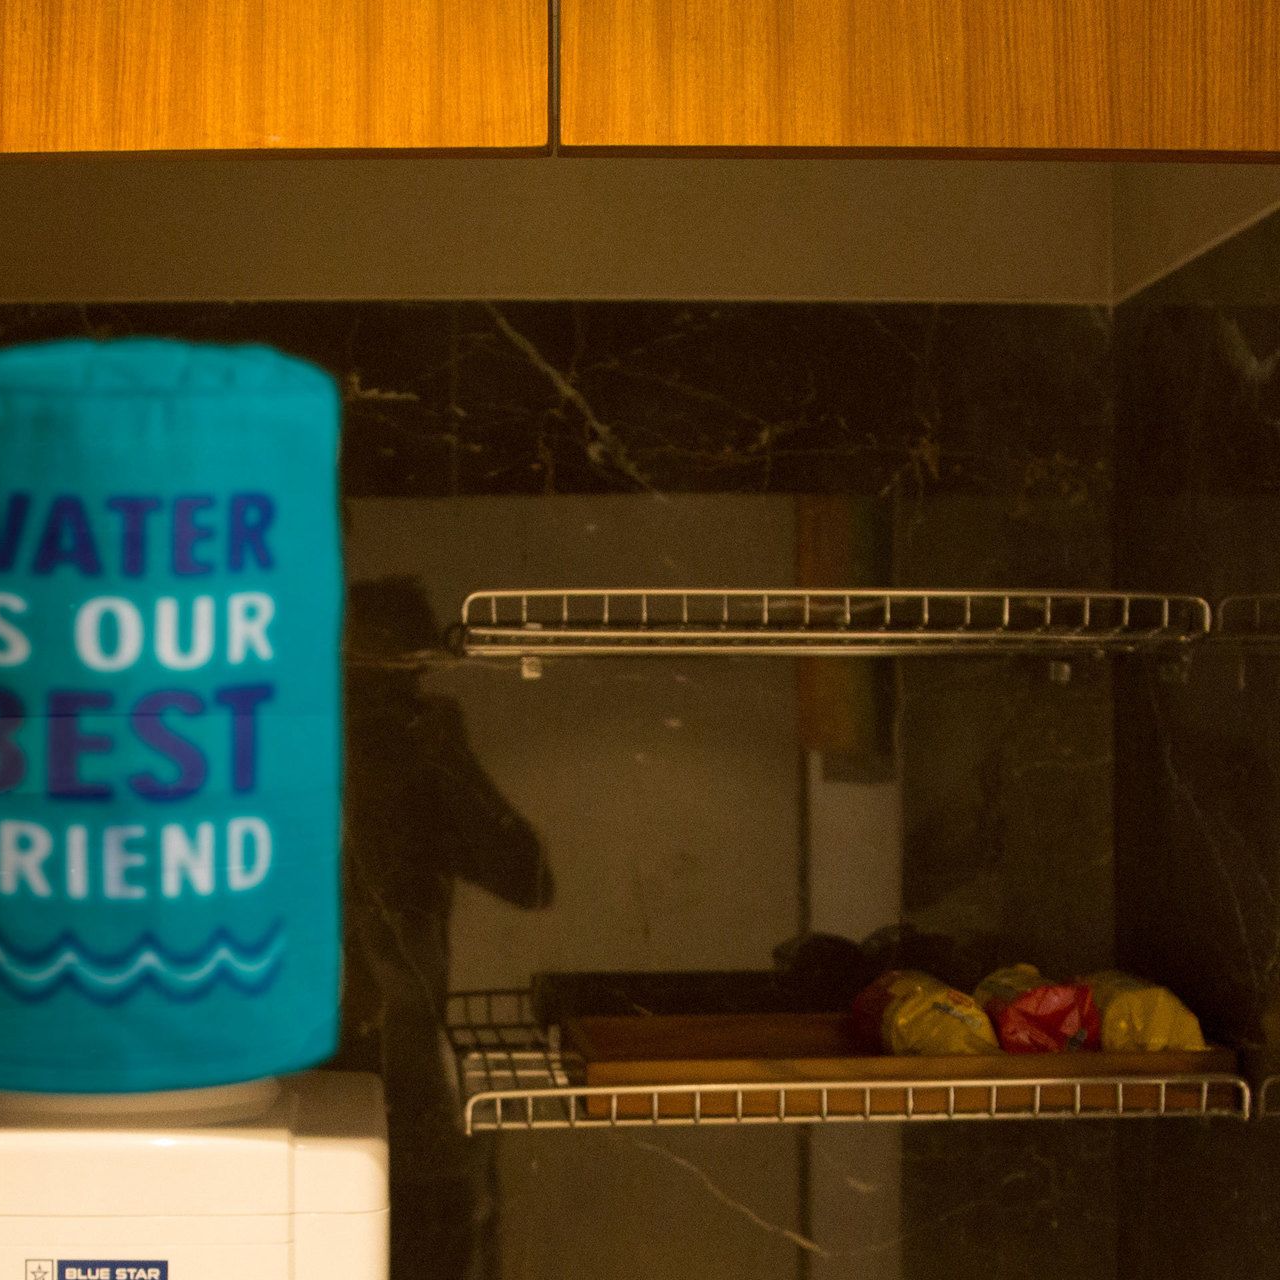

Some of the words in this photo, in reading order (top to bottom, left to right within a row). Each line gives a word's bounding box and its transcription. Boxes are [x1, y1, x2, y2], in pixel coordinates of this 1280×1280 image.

[73, 592, 276, 672] OUR
[64, 1267, 111, 1280] BLUE
[115, 1267, 161, 1280] STAR
